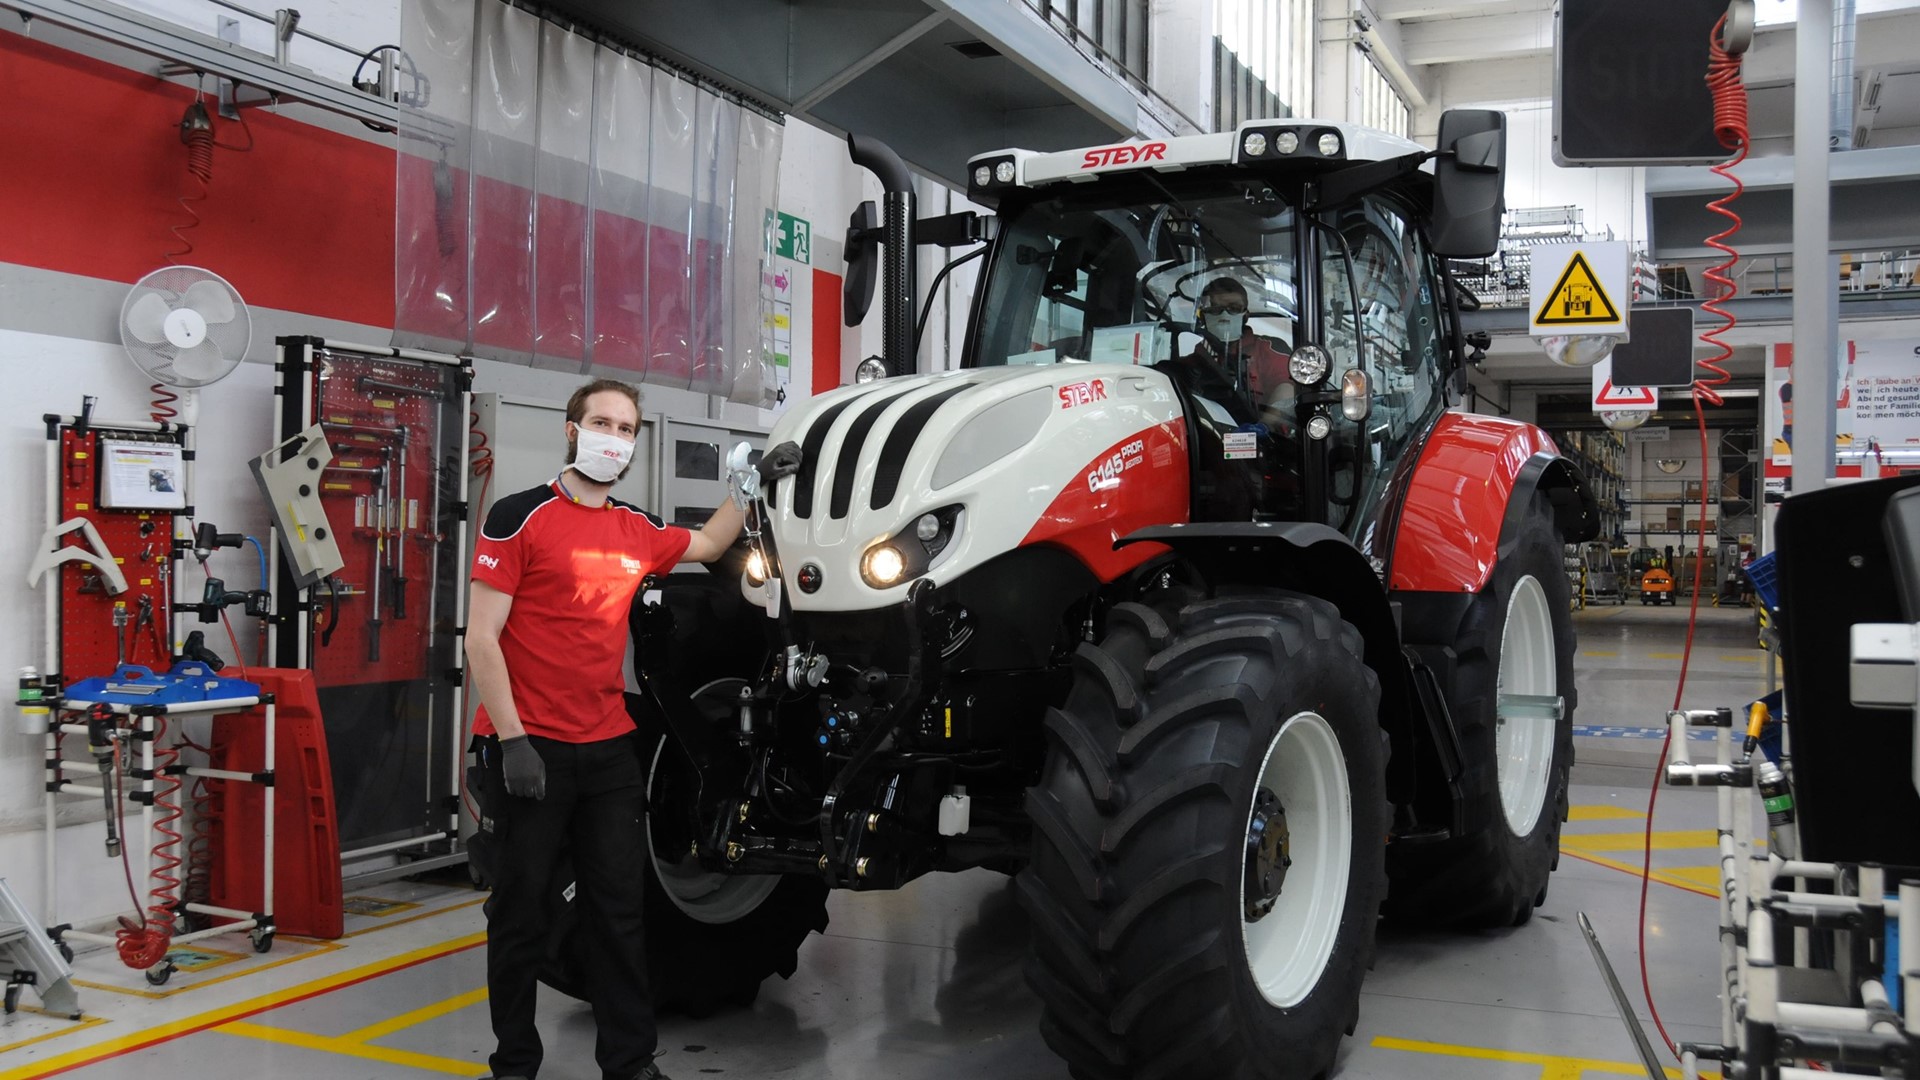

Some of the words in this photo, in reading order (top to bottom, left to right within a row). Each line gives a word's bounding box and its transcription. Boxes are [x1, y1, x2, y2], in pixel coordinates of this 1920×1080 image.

[1081, 143, 1167, 169] STEYR
[1058, 378, 1108, 410] STEYR
[1873, 377, 1899, 386] laube
[1088, 453, 1124, 493] 6145
[478, 554, 500, 568] CNH
